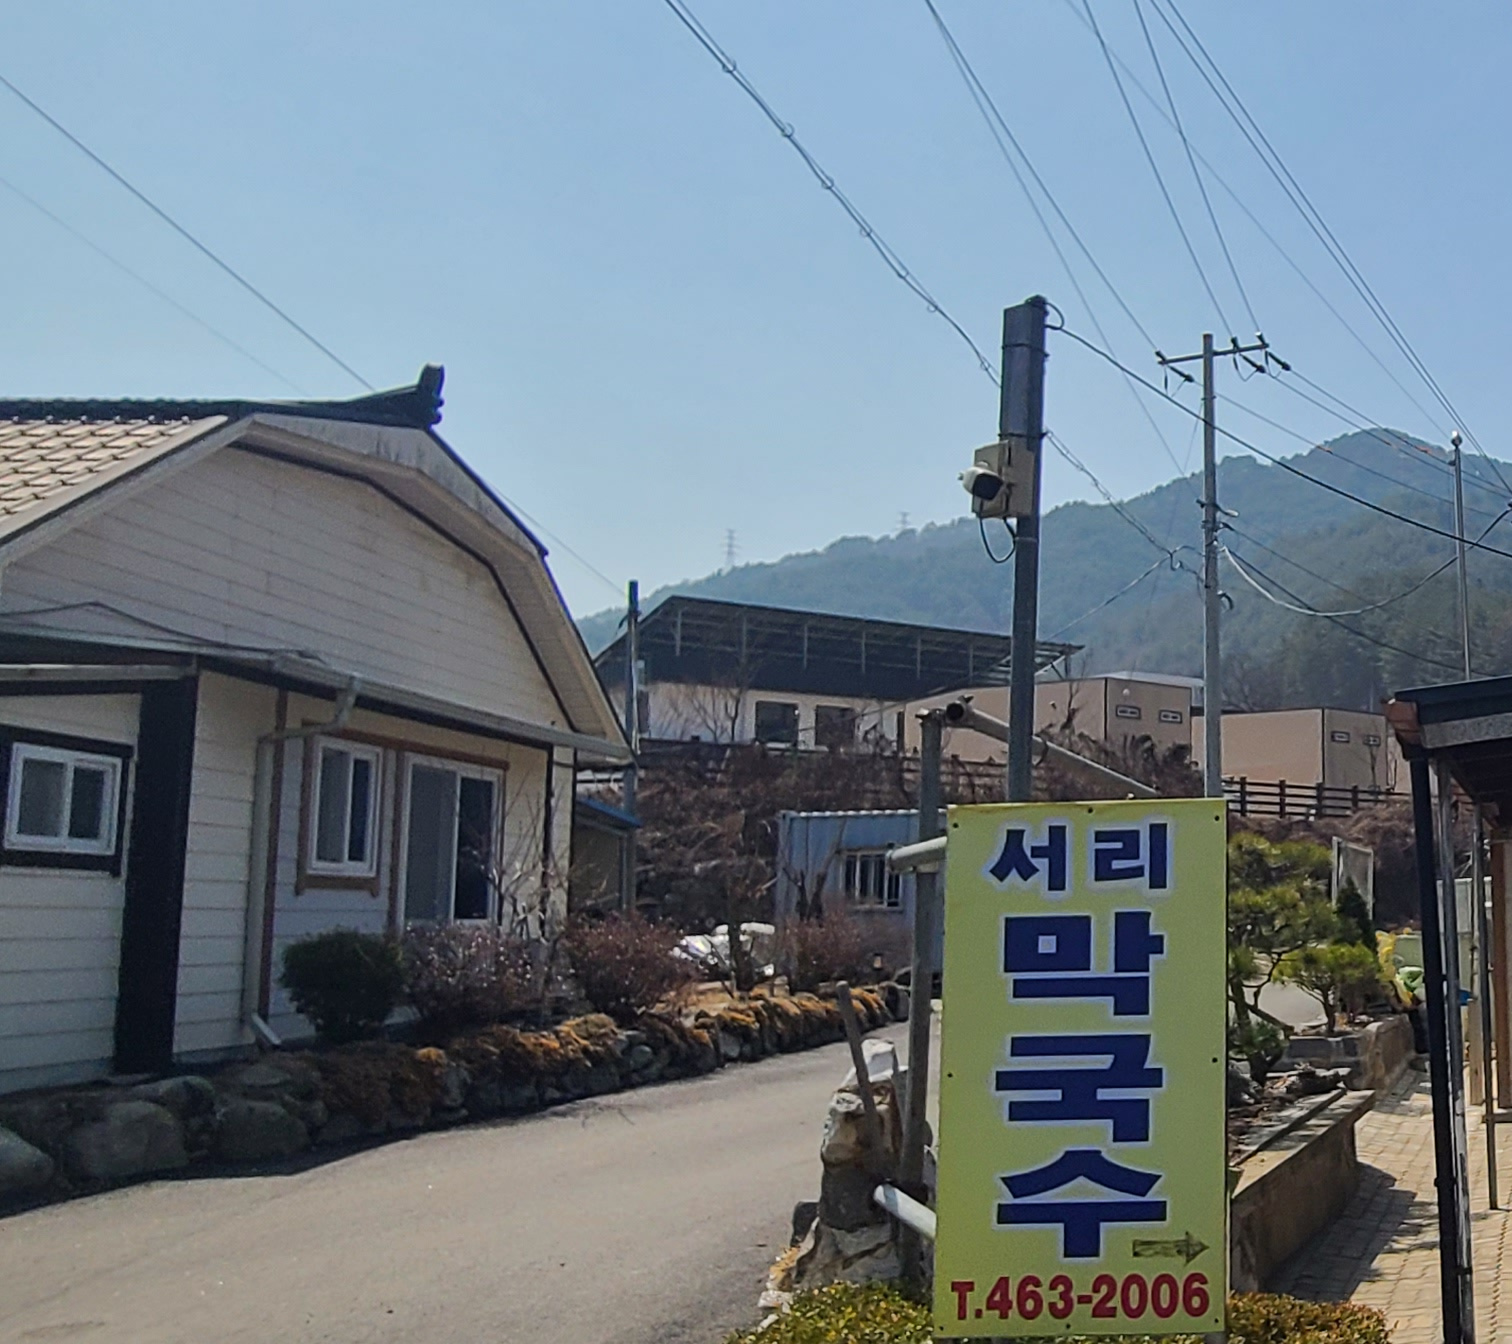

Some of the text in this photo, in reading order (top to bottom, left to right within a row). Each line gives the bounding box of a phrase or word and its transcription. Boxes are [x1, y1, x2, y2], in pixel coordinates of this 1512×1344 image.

[990, 822, 1168, 892] 서리
[994, 910, 1168, 1259] 막국수
[950, 1272, 1210, 1321] T.463-2006
